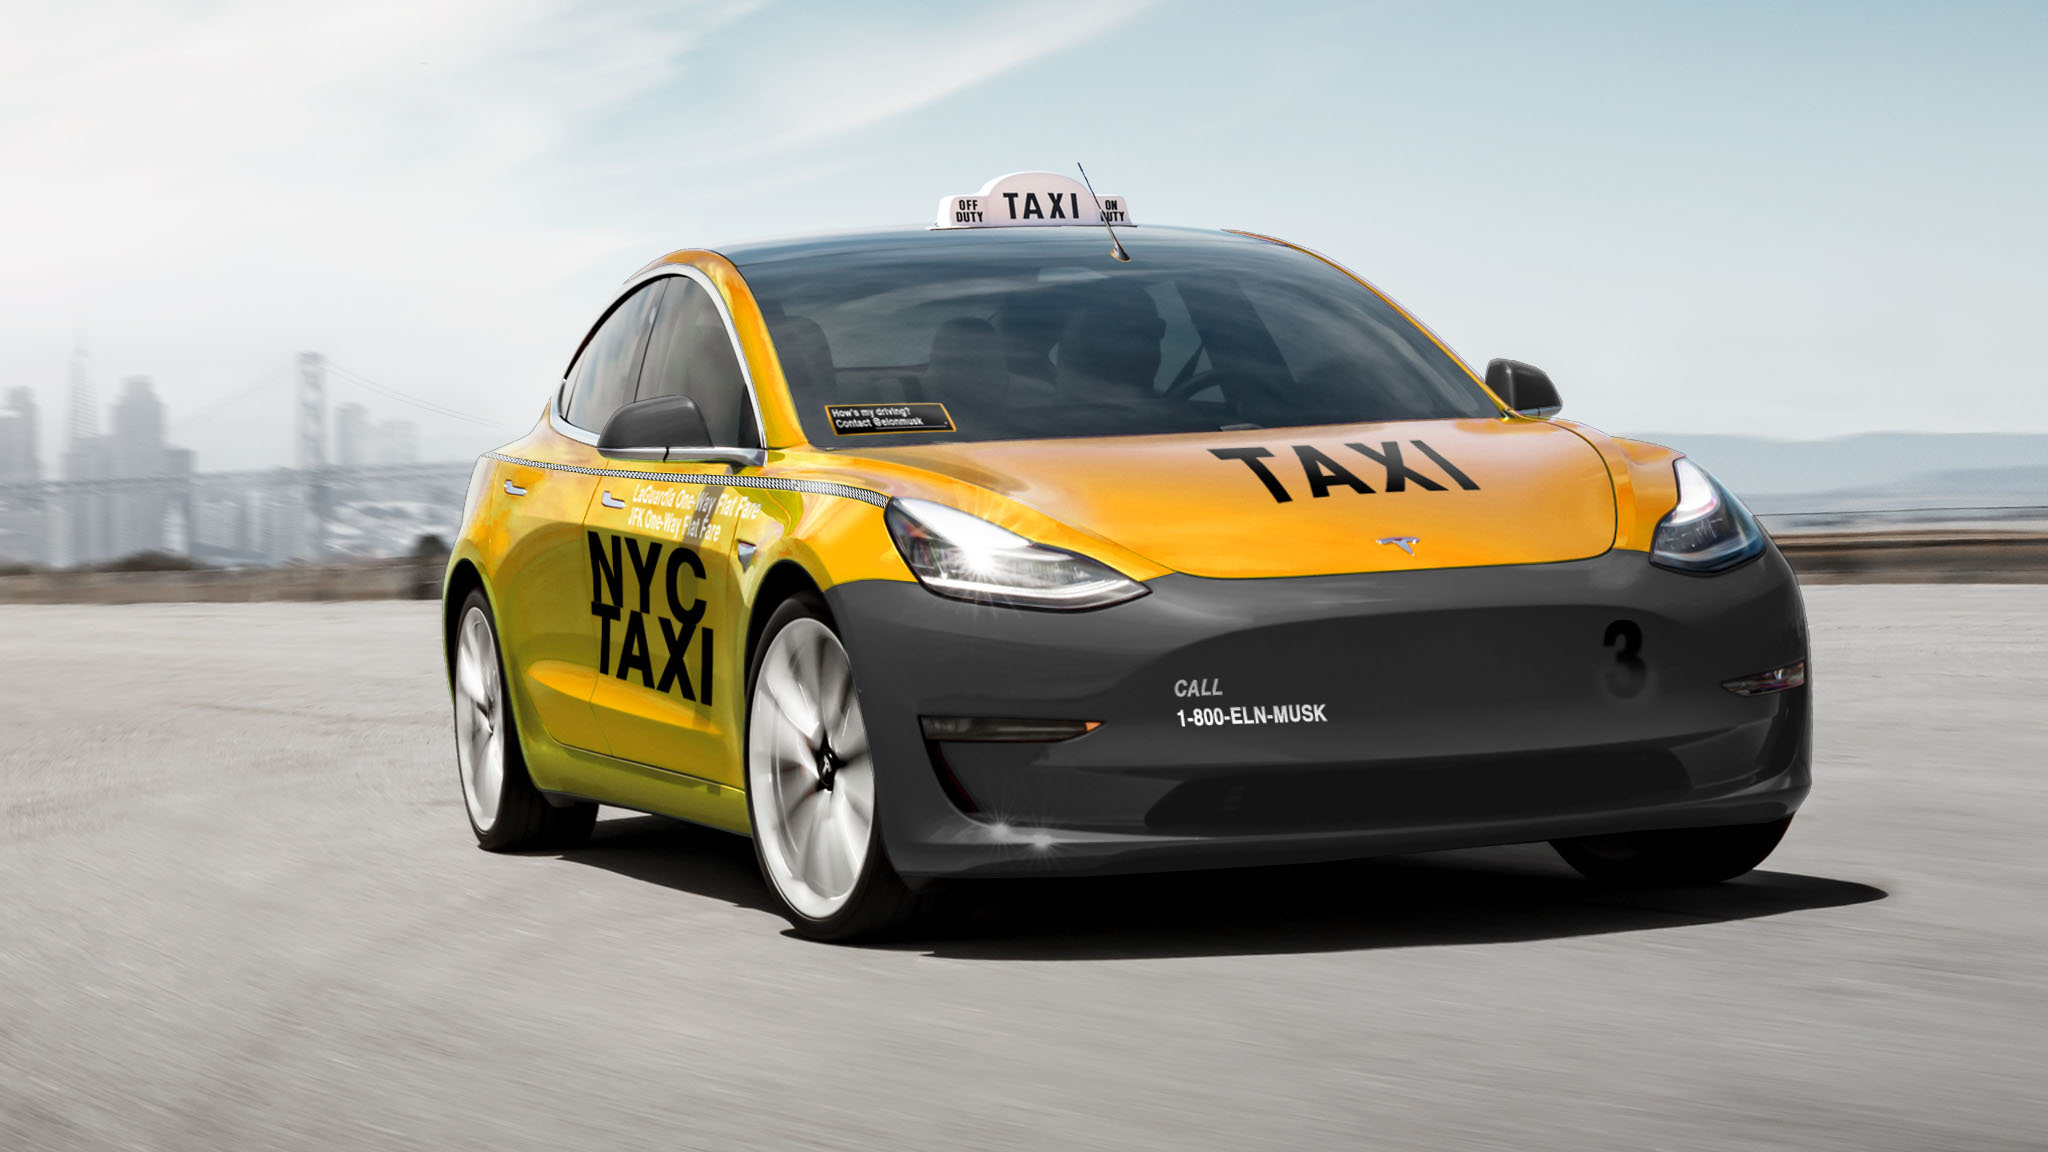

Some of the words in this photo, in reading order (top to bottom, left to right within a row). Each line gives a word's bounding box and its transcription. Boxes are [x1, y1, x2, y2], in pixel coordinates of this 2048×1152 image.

[956, 211, 983, 223] DUTY
[958, 199, 978, 211] OFF
[1002, 192, 1080, 219] TAXI
[1105, 200, 1118, 210] ON
[831, 408, 860, 418] How's
[861, 408, 874, 418] my
[875, 407, 912, 417] driving?
[835, 418, 873, 428] Contact
[872, 417, 924, 427] @elonmusk
[1206, 439, 1481, 504] TAXI
[632, 484, 675, 508] LaGuardia
[675, 489, 714, 514] One-Way
[715, 494, 736, 517] Flat
[734, 496, 762, 520] Fare
[627, 507, 645, 528] JFK
[645, 510, 682, 540] One-Way
[681, 515, 701, 539] Flat
[698, 518, 721, 542] Fare
[587, 530, 707, 626] NYC
[591, 600, 713, 706] TAXI
[1603, 619, 1648, 699] 3
[1174, 678, 1223, 697] CALL
[1177, 704, 1328, 727] 1-800-ELN-MUSK
